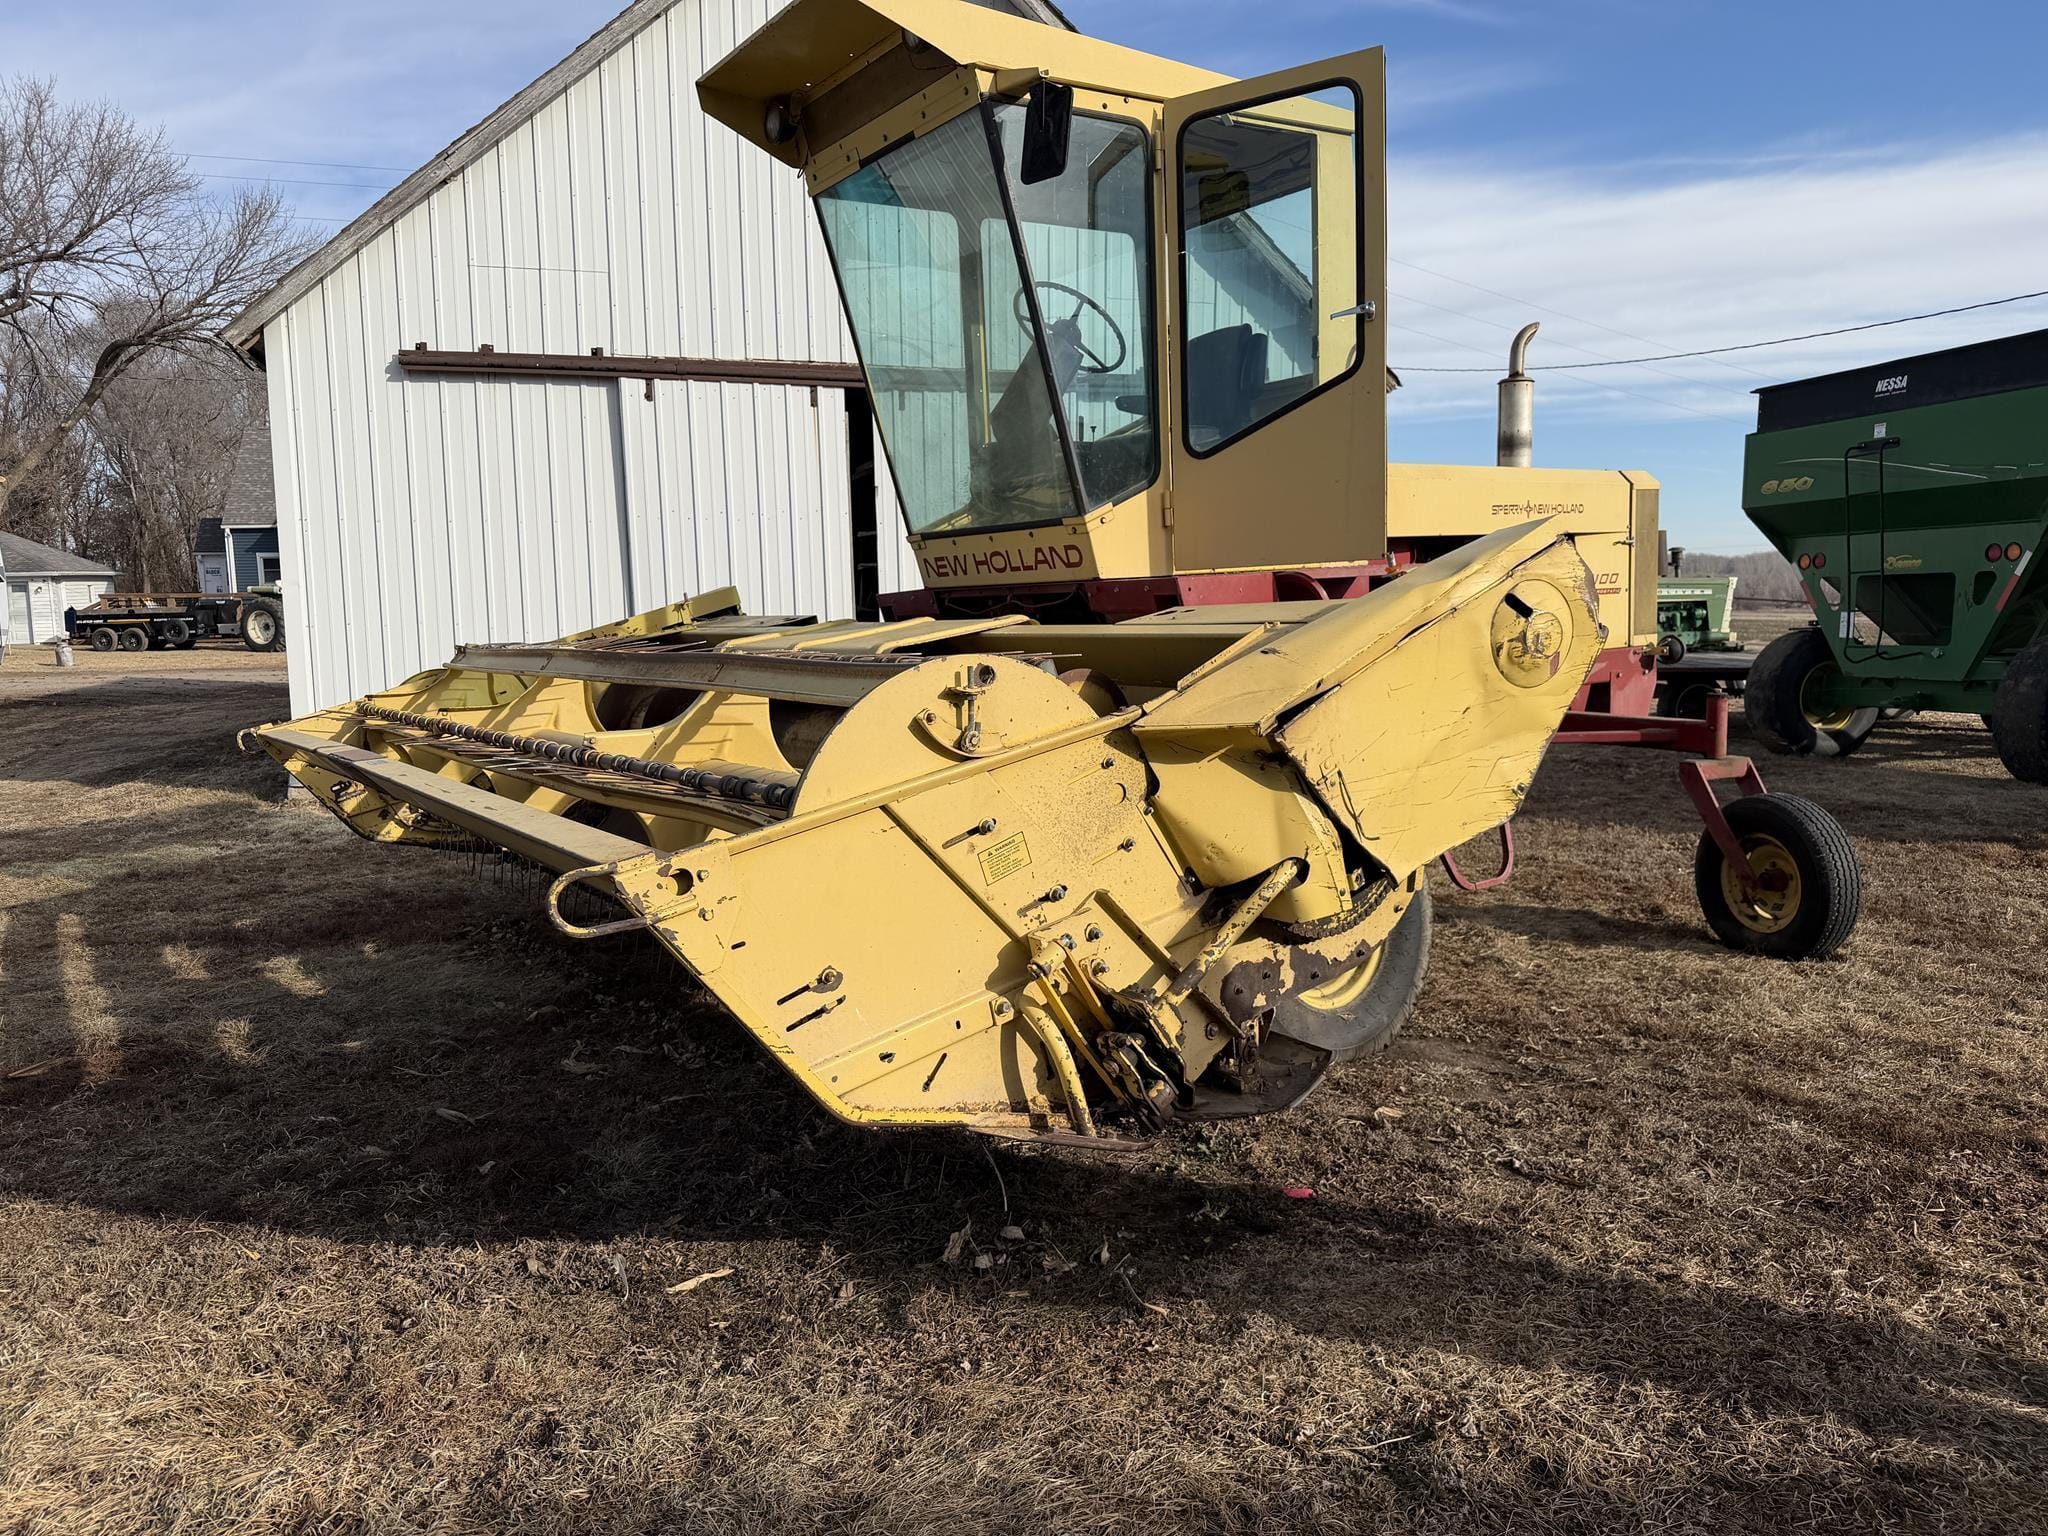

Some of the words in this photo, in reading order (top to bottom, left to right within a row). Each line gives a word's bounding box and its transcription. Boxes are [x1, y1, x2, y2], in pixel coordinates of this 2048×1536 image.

[1875, 374, 1908, 393] NESSA
[1491, 503, 1525, 515] SPERRY
[1533, 503, 1551, 514] NEW
[1551, 503, 1585, 513] HOLLAND
[923, 553, 968, 578] NEW
[972, 544, 1084, 574] HOLLAND
